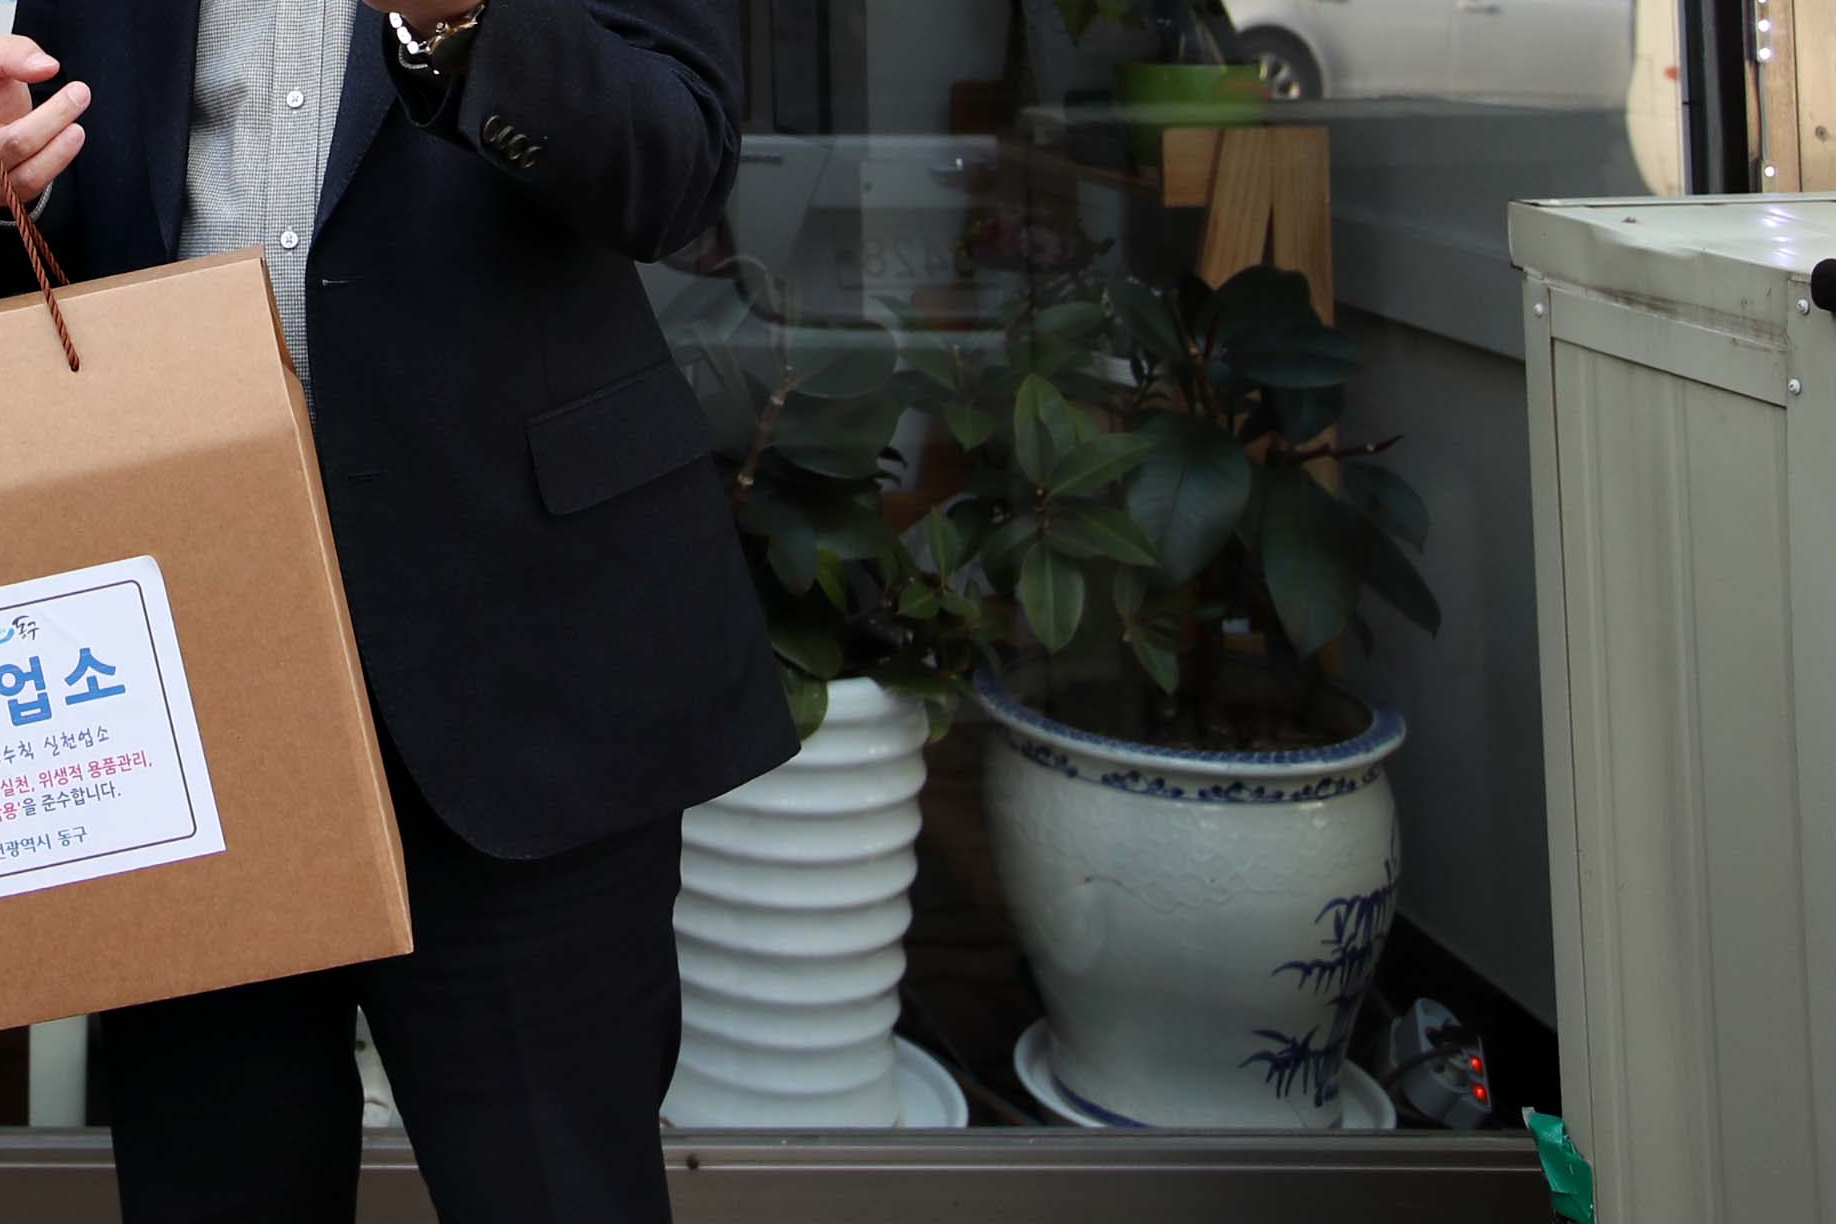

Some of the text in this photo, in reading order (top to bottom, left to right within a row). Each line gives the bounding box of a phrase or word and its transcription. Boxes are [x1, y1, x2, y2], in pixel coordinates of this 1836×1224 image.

[44, 726, 110, 757] 실천업소
[38, 764, 83, 789] 위생적
[41, 780, 122, 812] 준수합니다.
[57, 826, 88, 847] 동구
